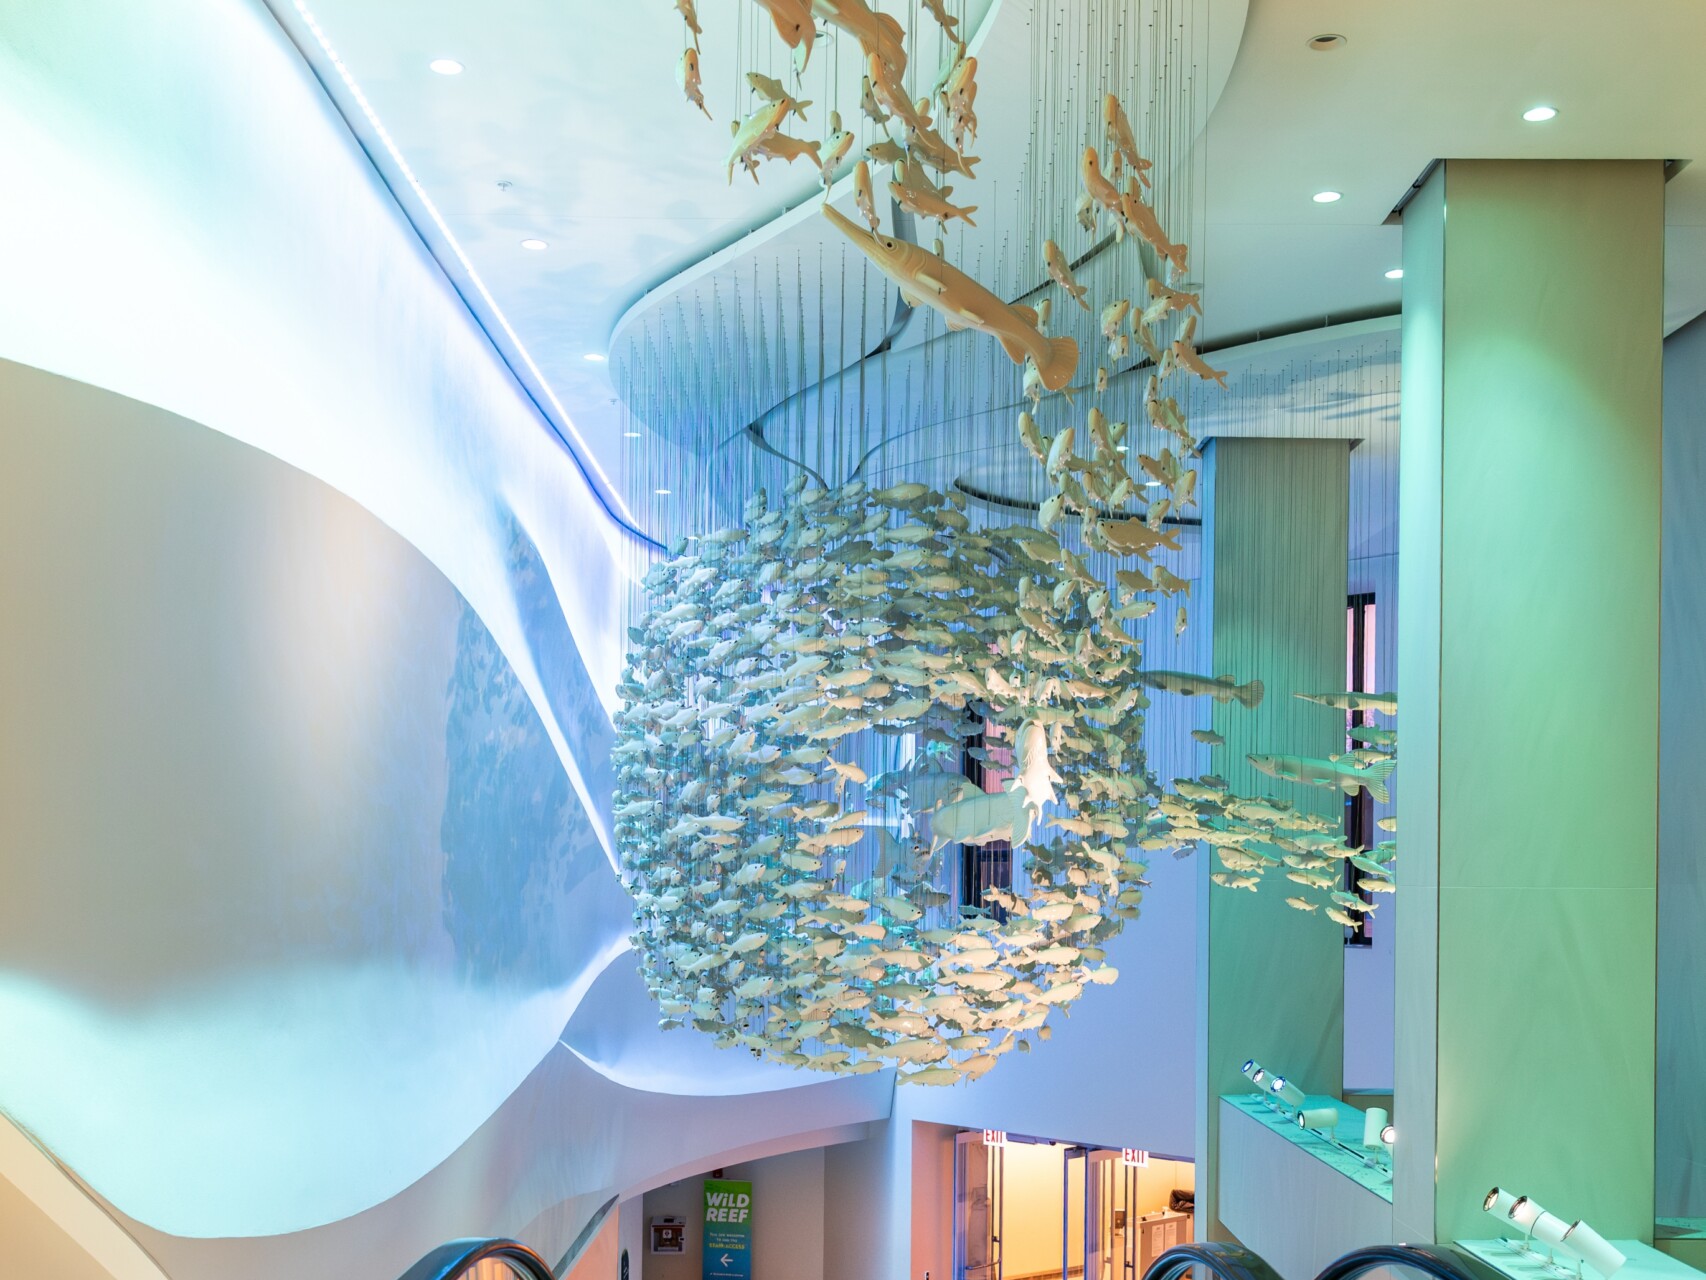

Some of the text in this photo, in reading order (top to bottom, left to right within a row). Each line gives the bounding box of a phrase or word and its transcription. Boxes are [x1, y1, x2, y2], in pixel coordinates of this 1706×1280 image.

[985, 1129, 1003, 1143] EXIT
[1125, 1148, 1144, 1163] EXIT
[705, 1207, 749, 1223] REEF
